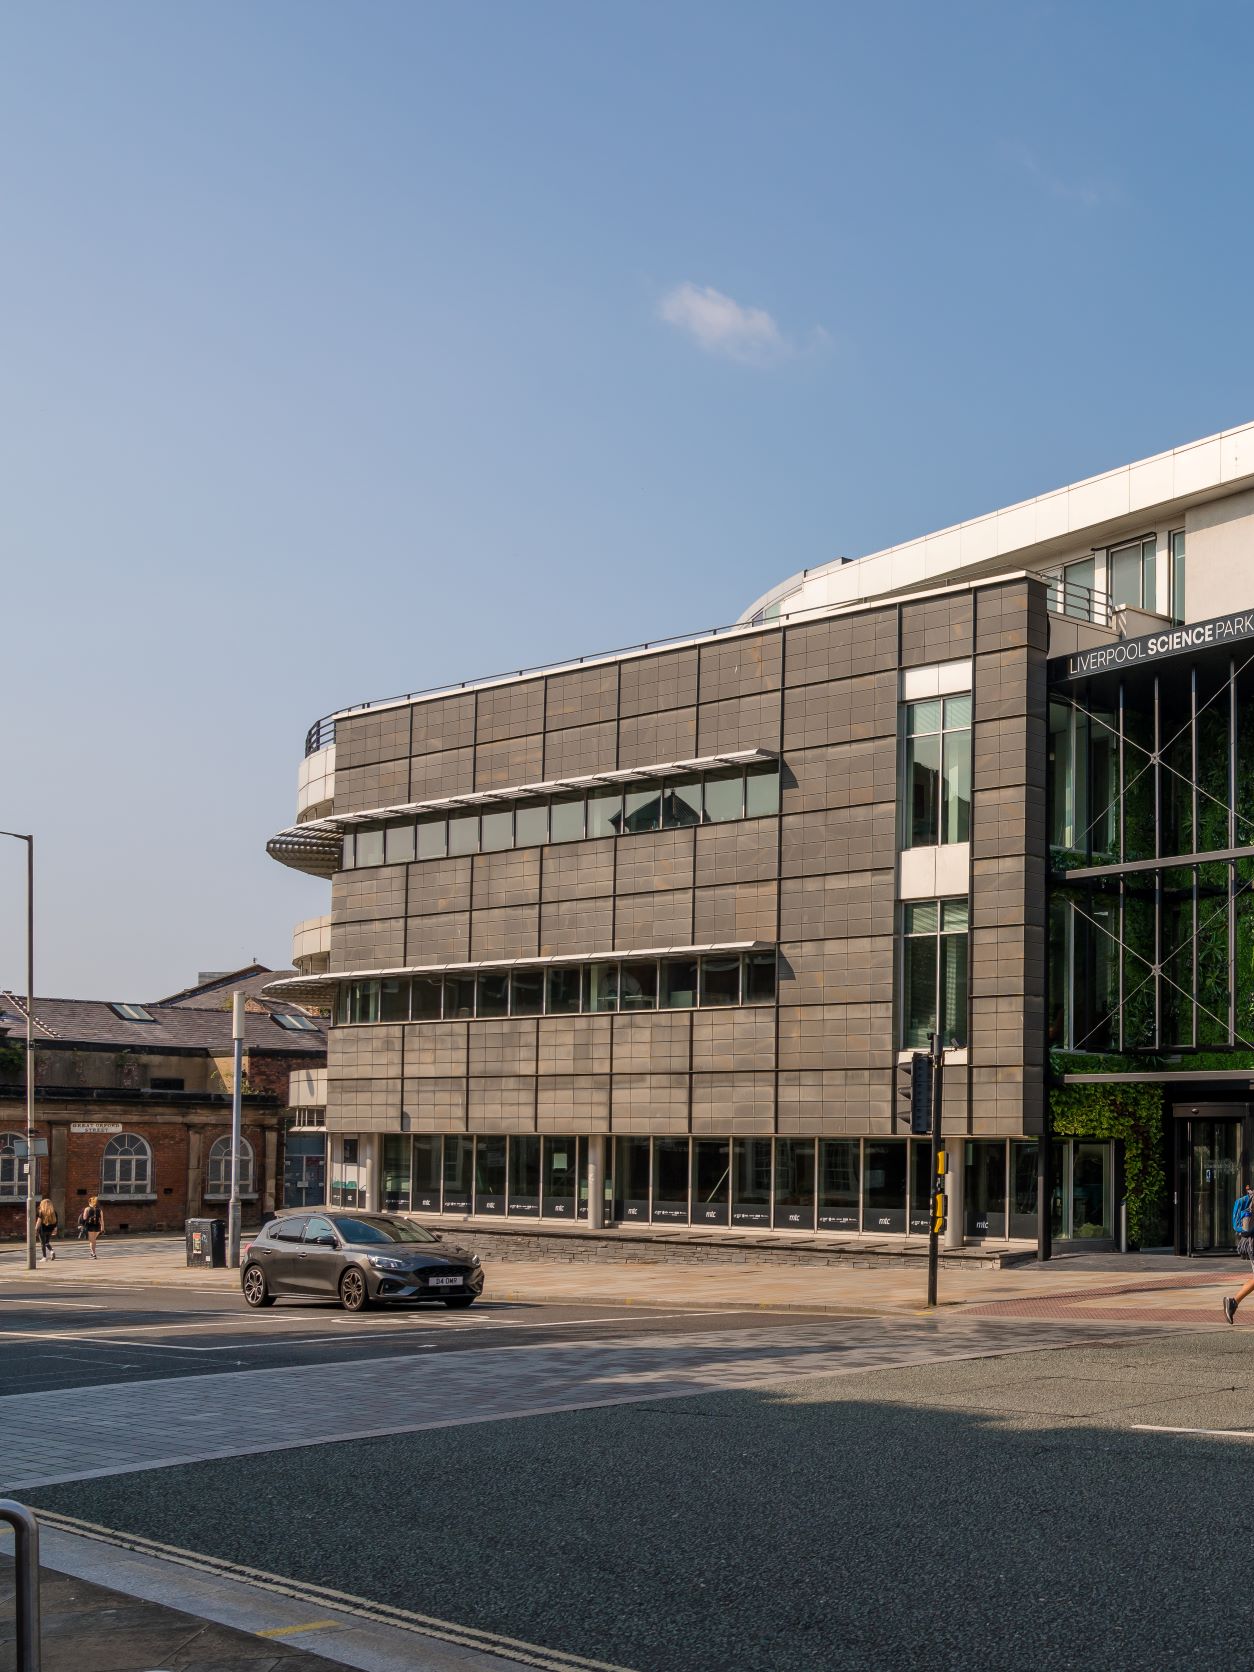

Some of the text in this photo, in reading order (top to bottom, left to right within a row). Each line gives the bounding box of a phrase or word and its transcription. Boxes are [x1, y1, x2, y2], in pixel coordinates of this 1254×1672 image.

[1069, 614, 1254, 674] LIVERPOOL SCIENCE PARK
